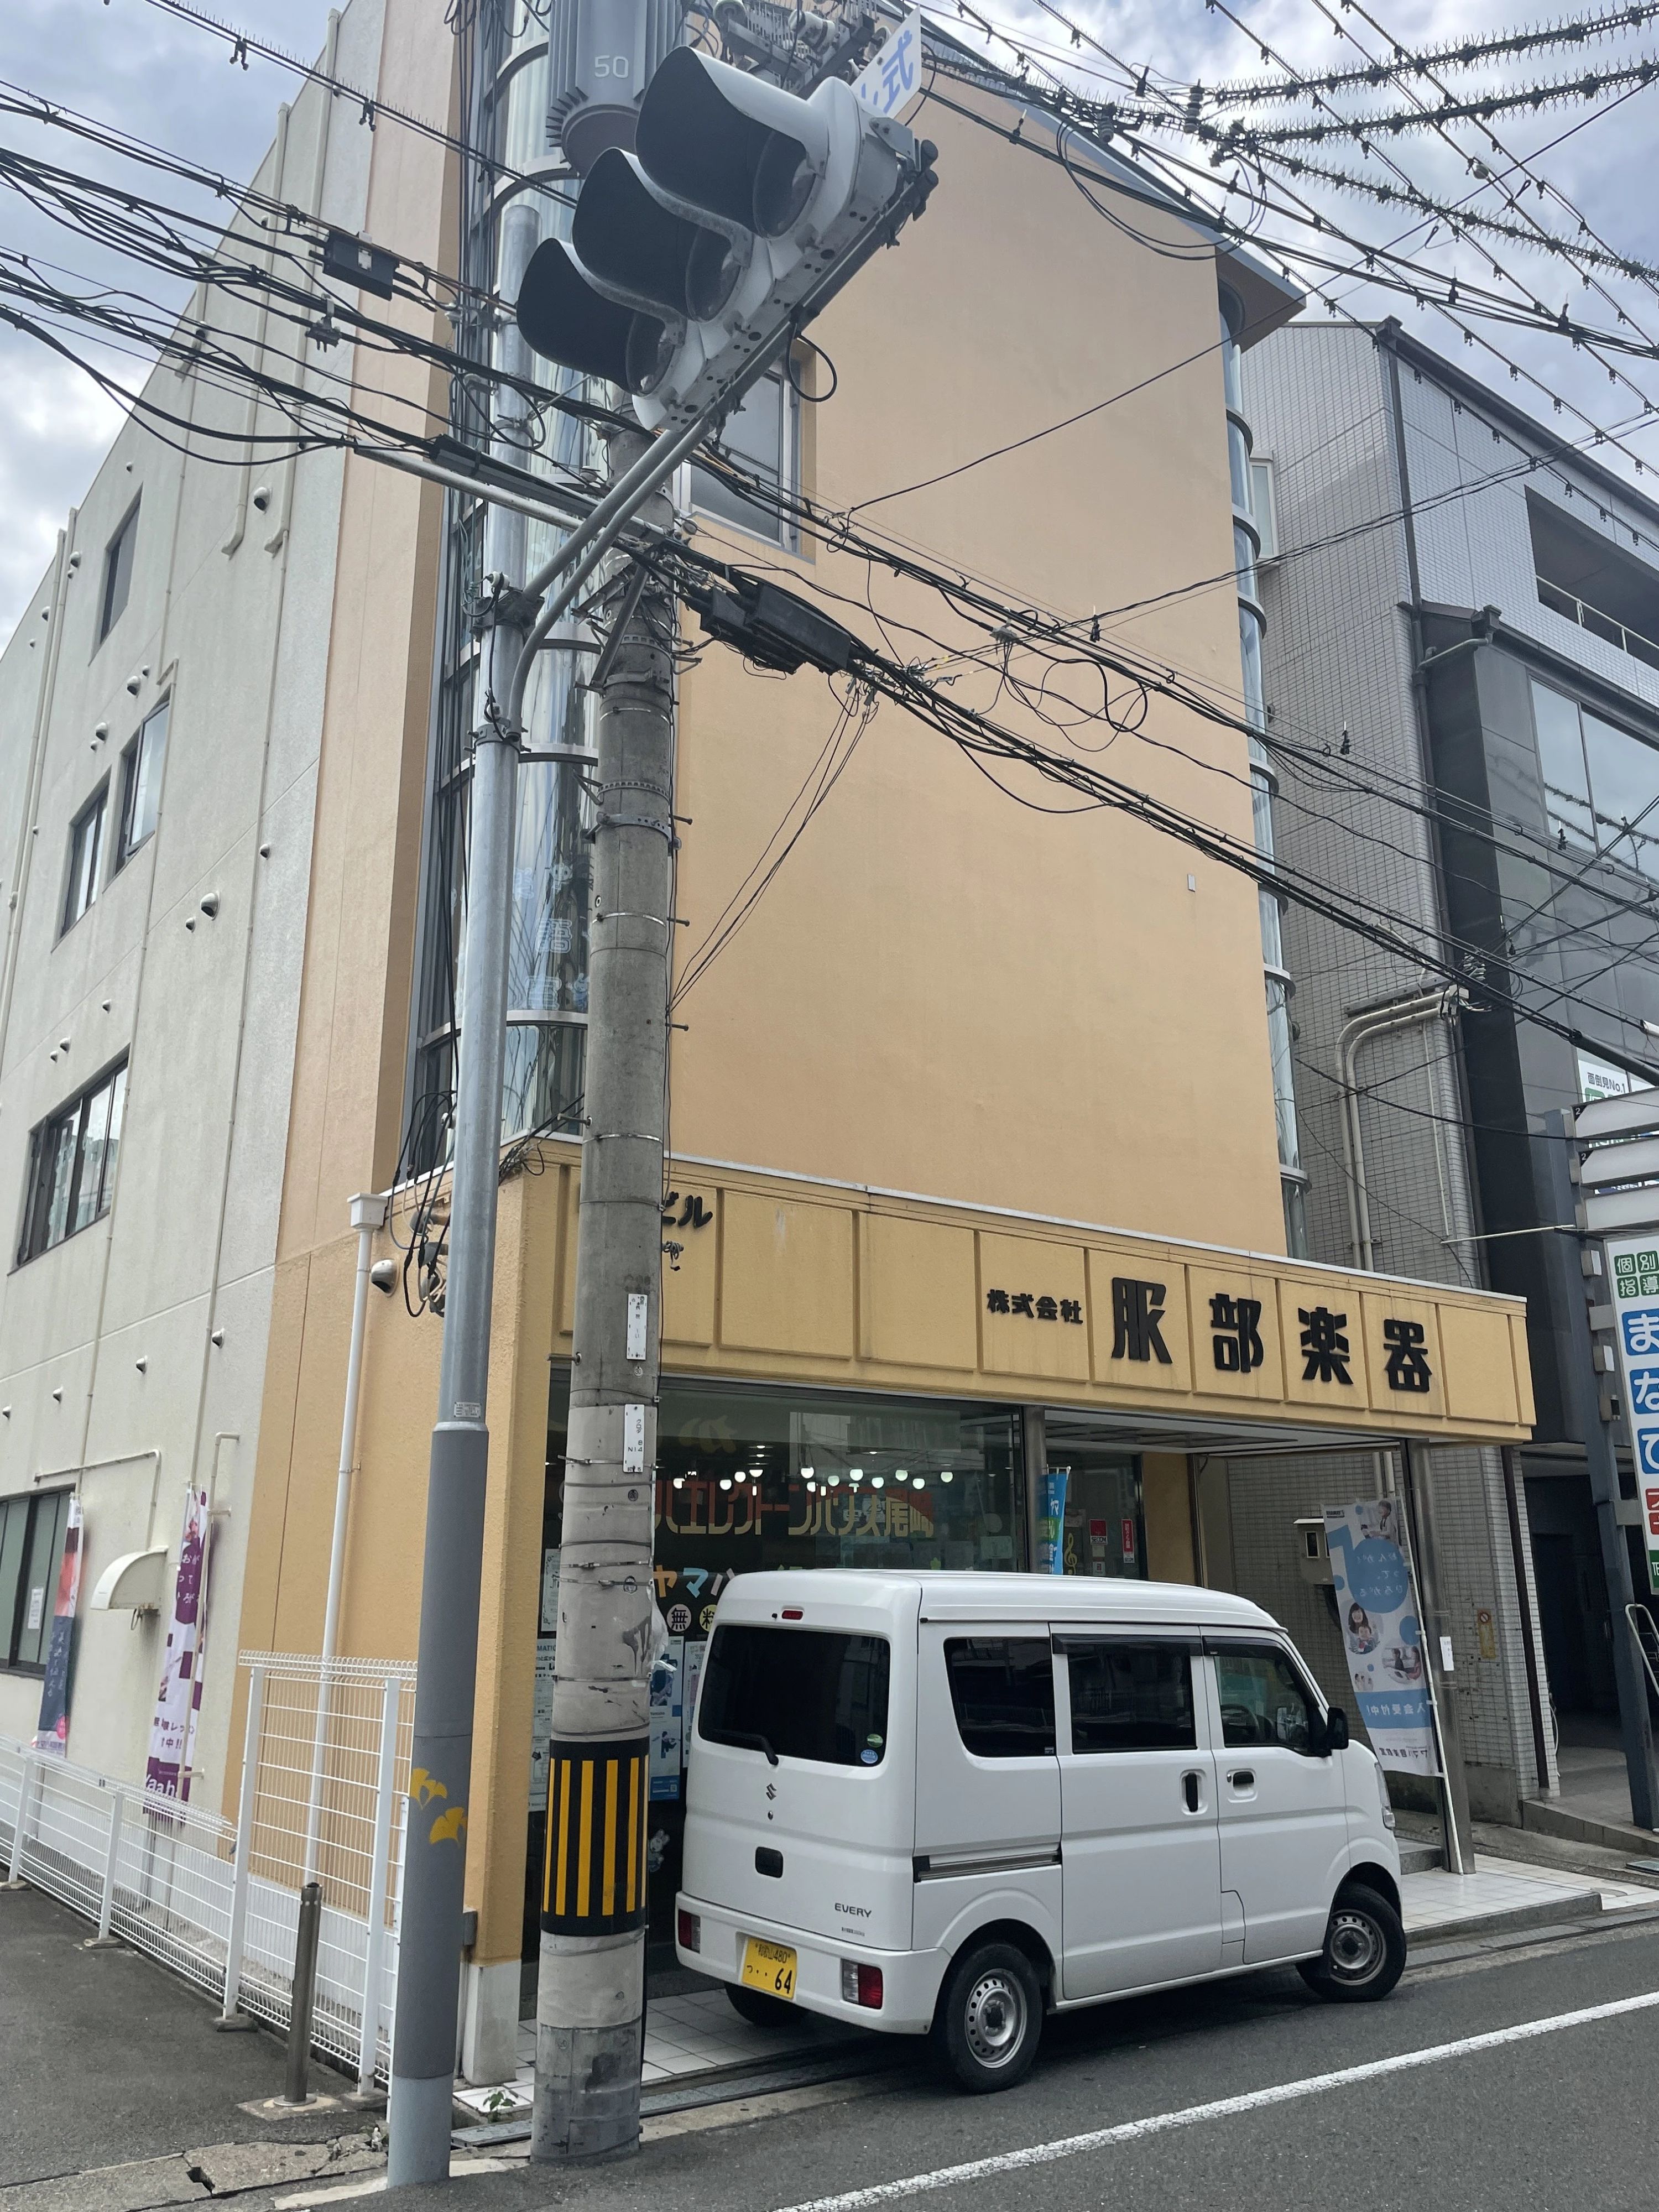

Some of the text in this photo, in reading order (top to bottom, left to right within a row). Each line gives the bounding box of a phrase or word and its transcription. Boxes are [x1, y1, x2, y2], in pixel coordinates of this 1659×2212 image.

[593, 54, 629, 80] 50
[1575, 1107, 1581, 1116] 2
[1580, 1152, 1587, 1161] 2
[1616, 1253, 1656, 1274] 個別
[987, 1276, 1433, 1394] 株式会社 服部楽器
[834, 1902, 872, 1918] EVERY
[775, 1968, 792, 1994] 64
